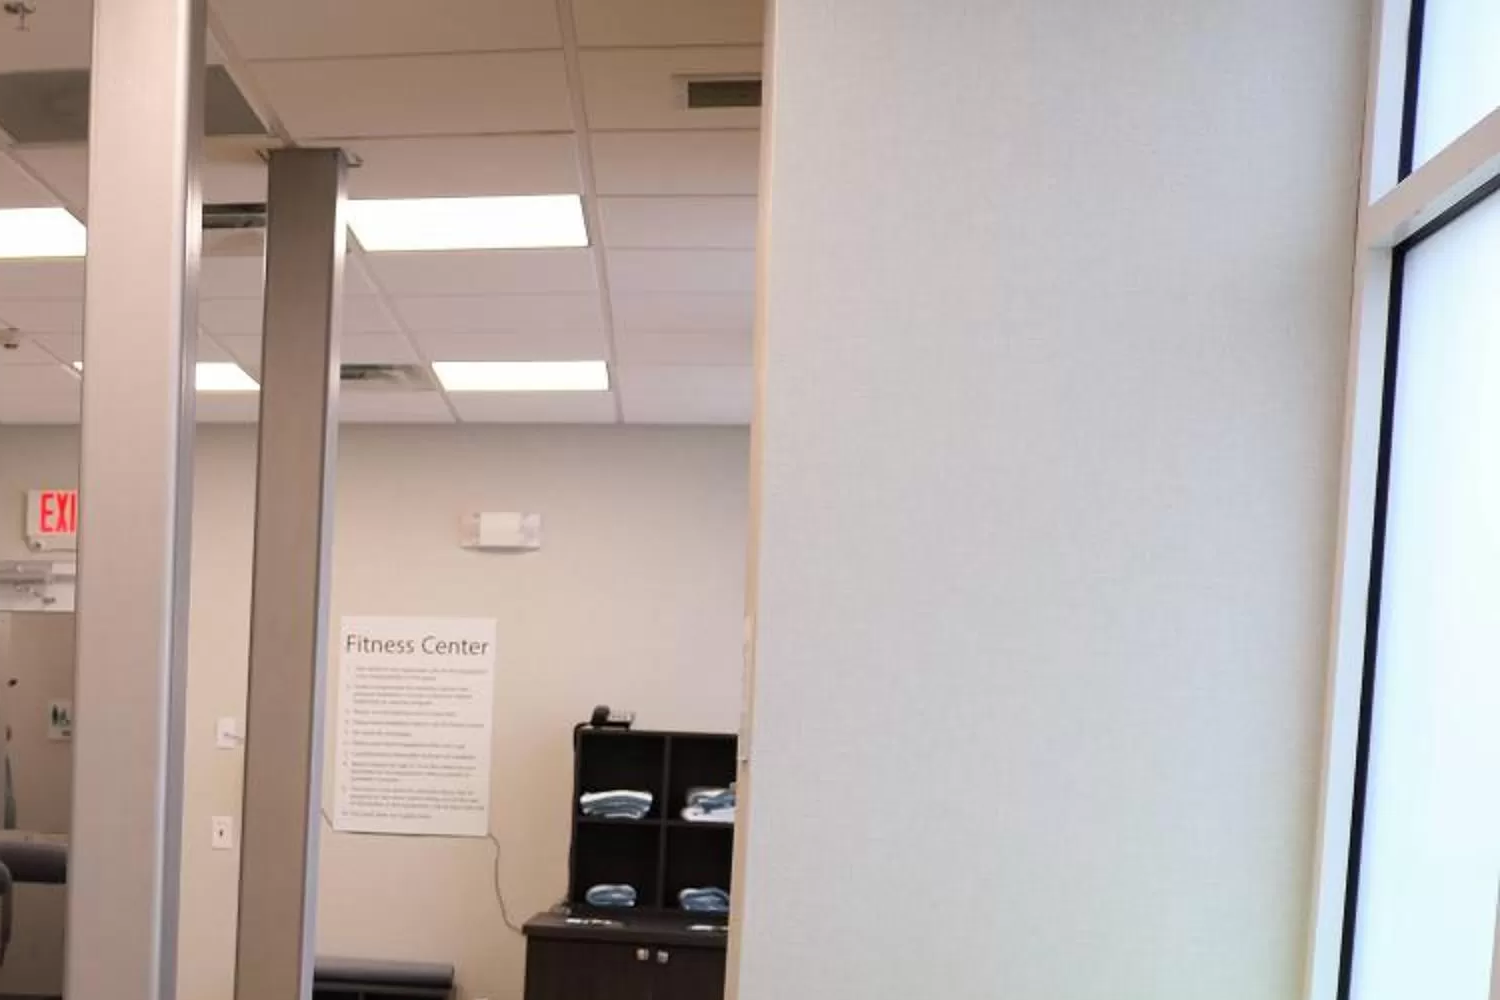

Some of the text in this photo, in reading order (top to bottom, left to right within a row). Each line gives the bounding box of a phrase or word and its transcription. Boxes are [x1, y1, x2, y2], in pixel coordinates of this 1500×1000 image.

[41, 492, 77, 533] EXI
[346, 633, 490, 656] Fitness Center
